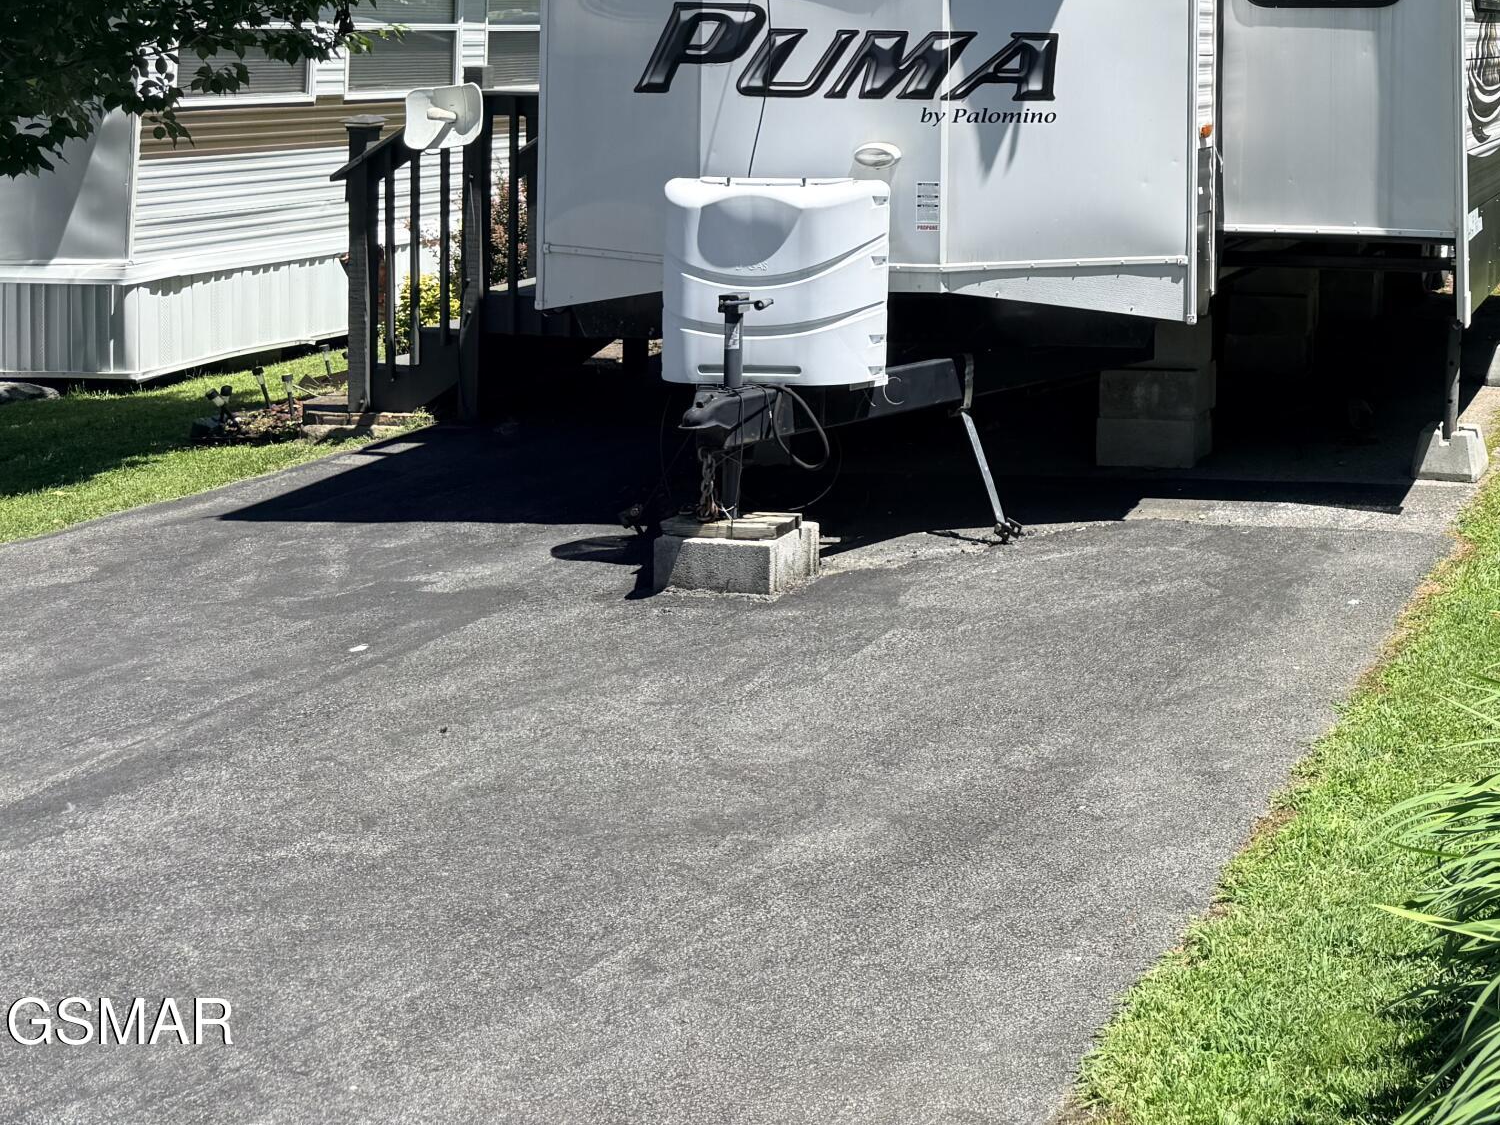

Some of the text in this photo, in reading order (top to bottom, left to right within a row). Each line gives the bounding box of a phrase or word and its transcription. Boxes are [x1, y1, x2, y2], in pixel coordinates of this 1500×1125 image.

[634, 2, 1059, 101] PUMA
[920, 107, 1057, 127] by Palomino
